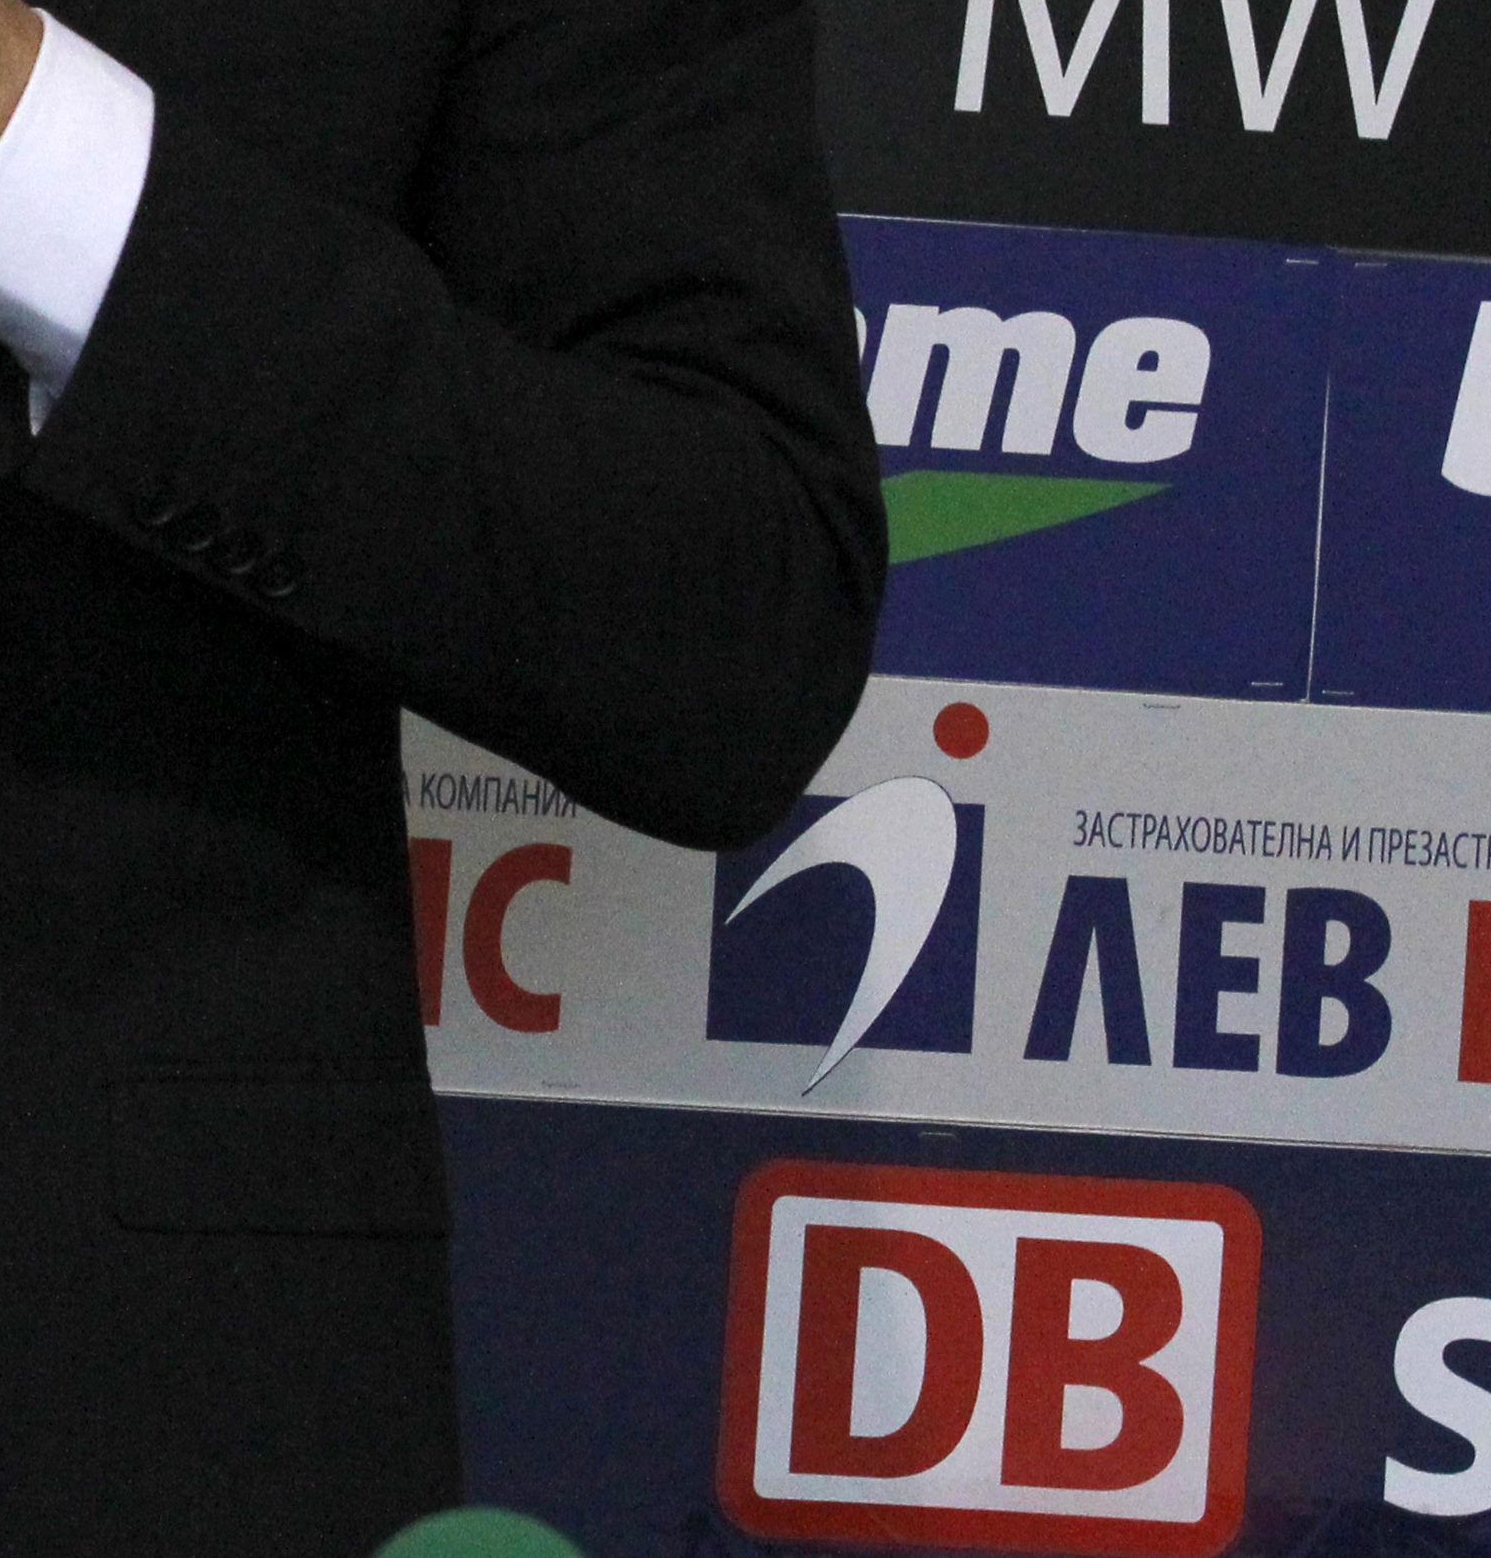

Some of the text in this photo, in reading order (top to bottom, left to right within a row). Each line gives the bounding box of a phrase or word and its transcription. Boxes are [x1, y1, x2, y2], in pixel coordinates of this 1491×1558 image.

[853, 304, 1212, 464] me
[1073, 810, 1332, 860] ЗАСТРАХОВАТЕЛНА
[1342, 826, 1360, 862] И
[1023, 875, 1392, 1078] ЛЕВ
[789, 1223, 1185, 1492] DB
